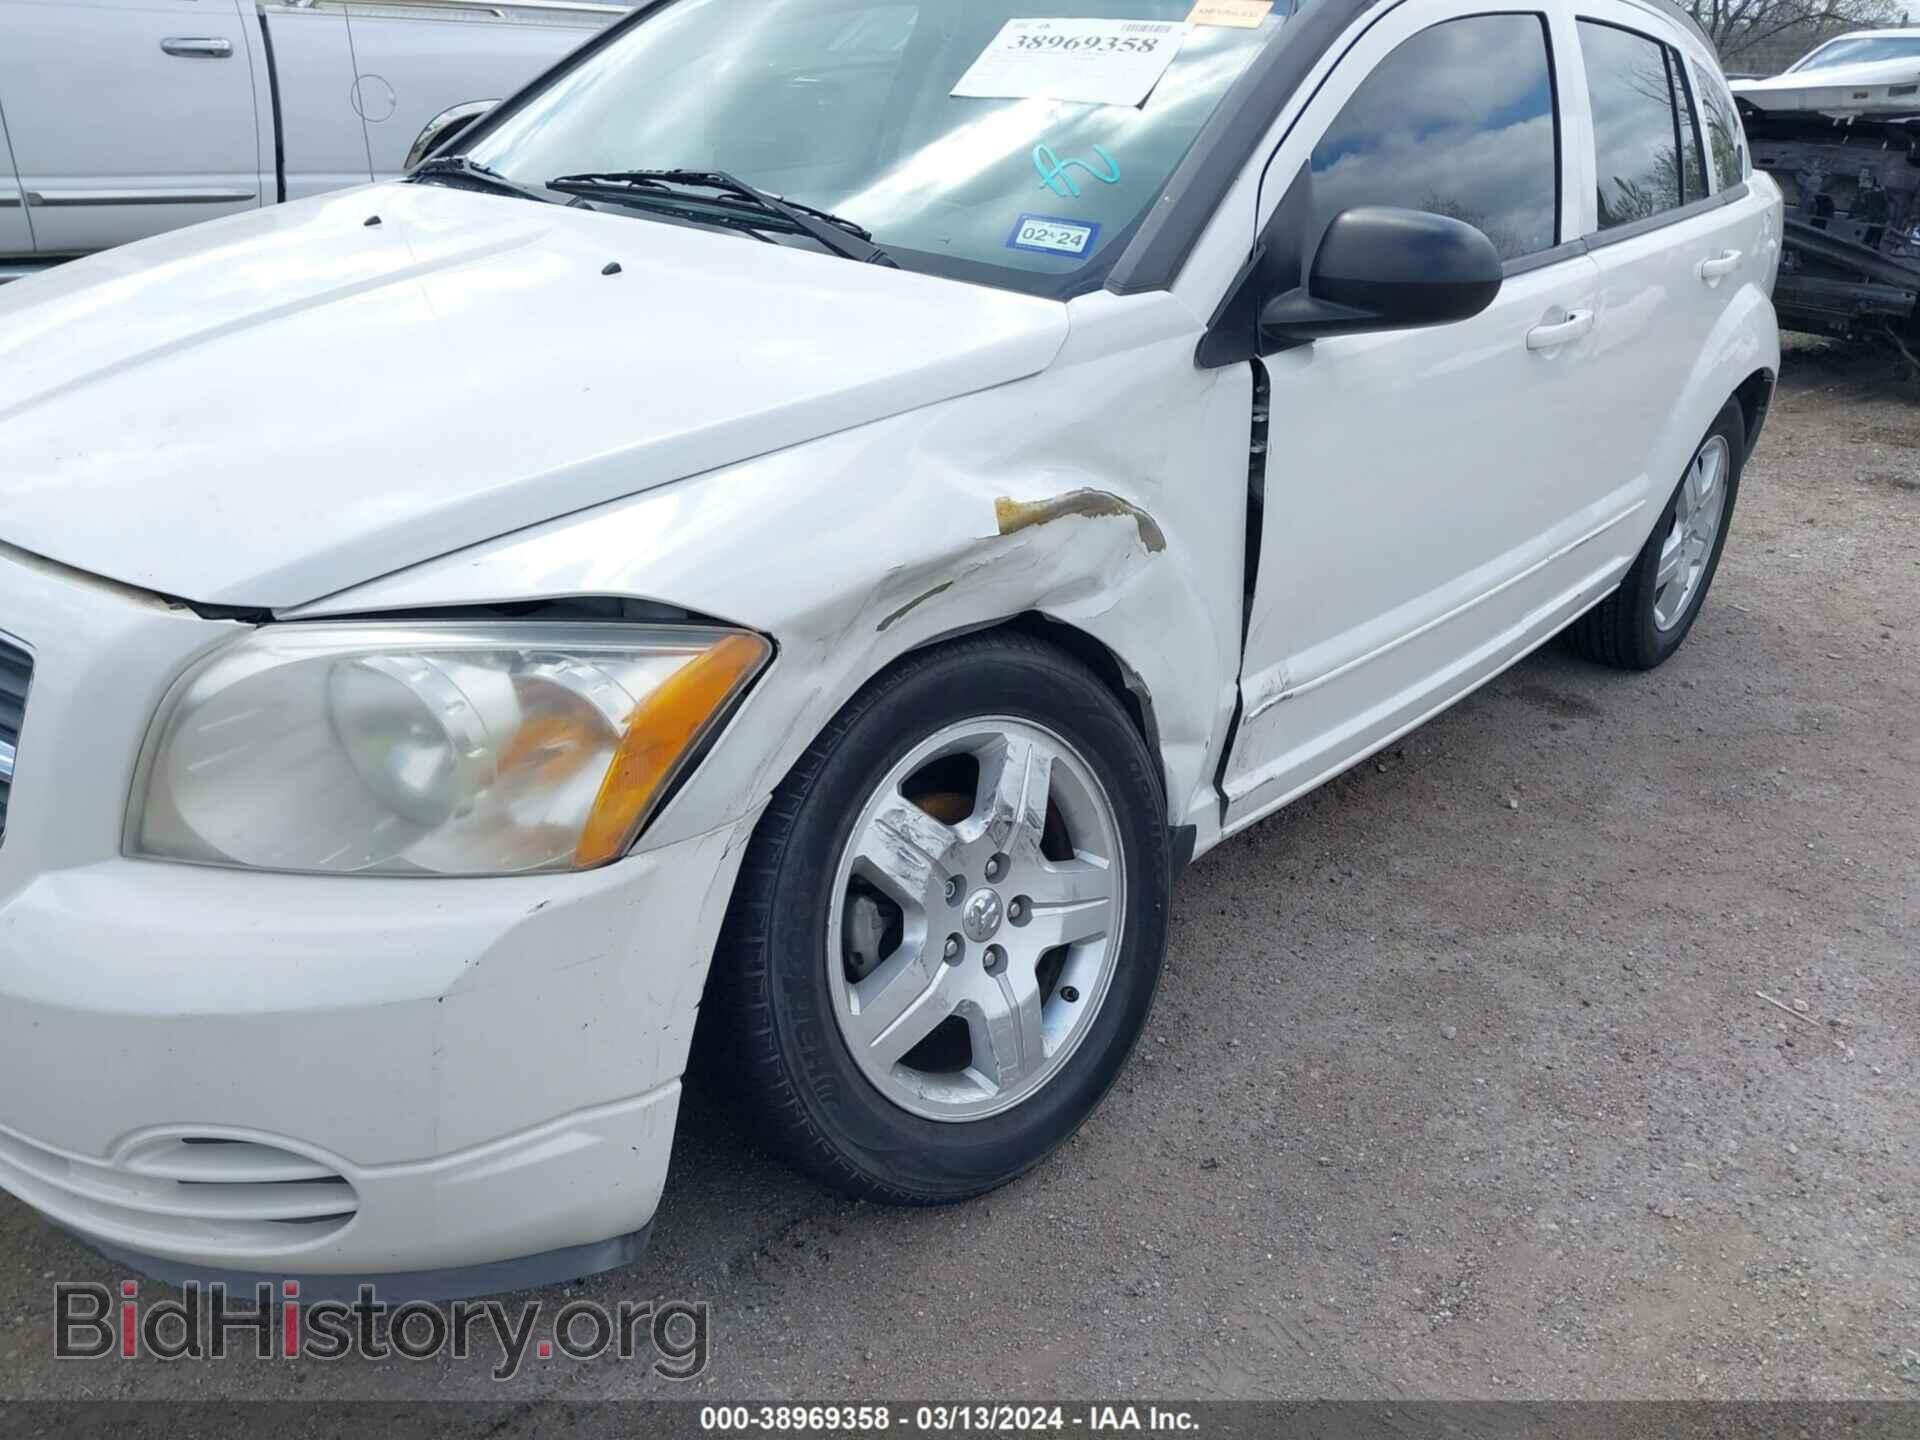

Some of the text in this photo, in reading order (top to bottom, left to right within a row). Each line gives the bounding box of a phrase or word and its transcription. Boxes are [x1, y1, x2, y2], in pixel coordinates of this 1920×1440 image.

[1008, 35, 1159, 53] 38969358
[1022, 227, 1083, 247] 02 24
